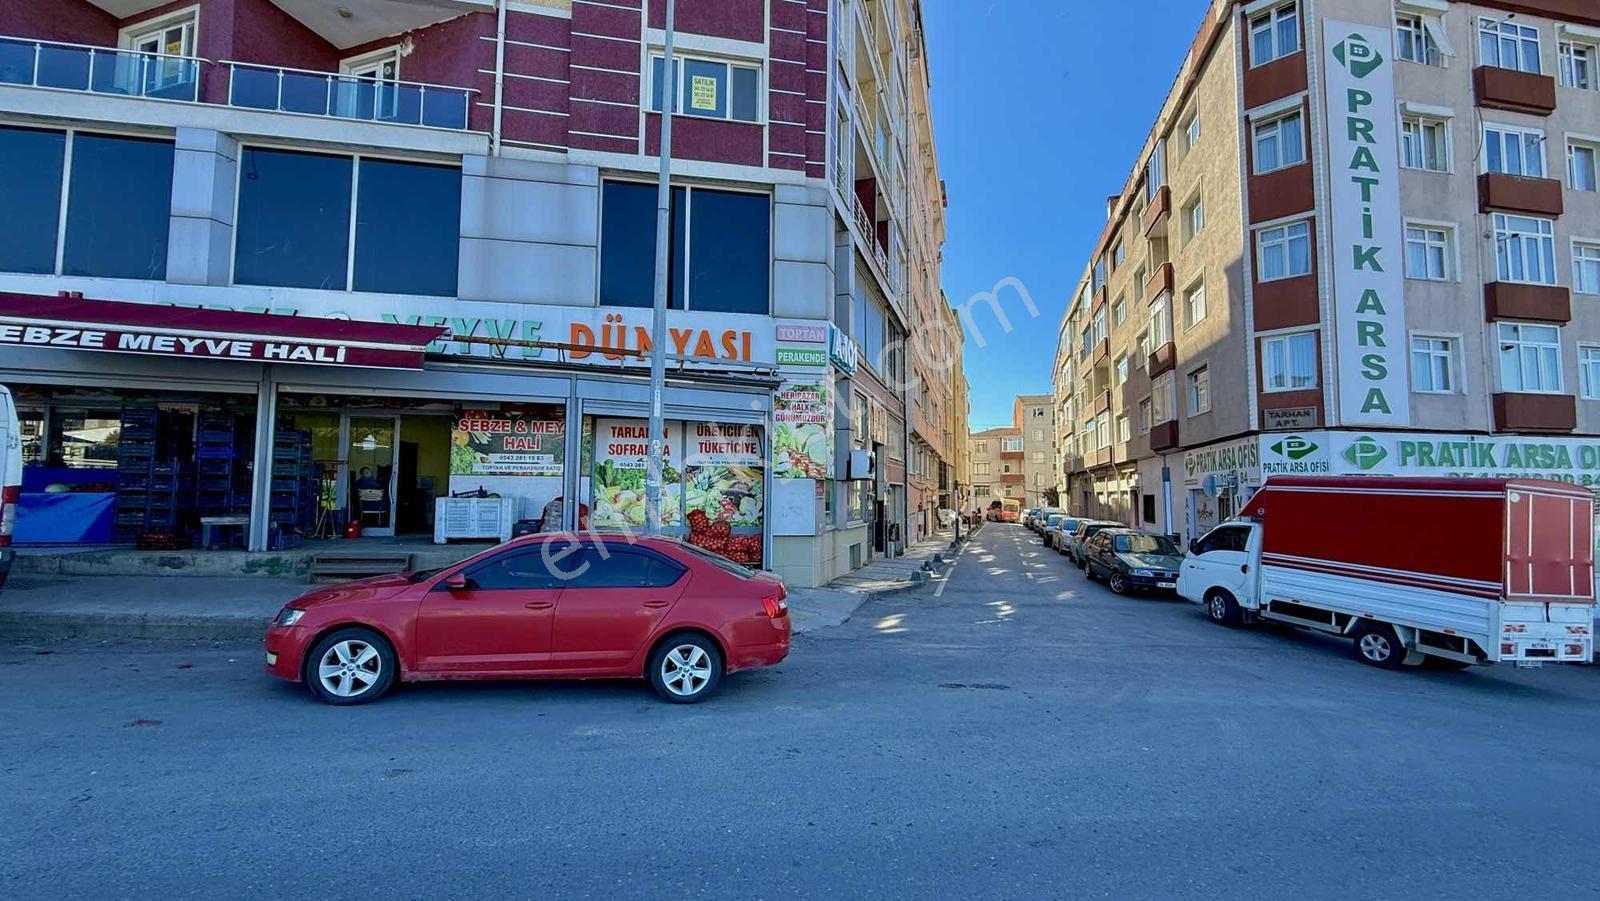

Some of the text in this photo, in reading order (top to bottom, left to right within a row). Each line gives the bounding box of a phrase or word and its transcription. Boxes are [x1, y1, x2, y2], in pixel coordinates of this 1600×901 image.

[1346, 88, 1392, 415] PRATİK ARSA
[779, 328, 825, 340] TOPTAN
[118, 333, 253, 357] MEYVE
[263, 342, 346, 363] HALİ
[778, 351, 826, 363] PERAKENDE
[781, 391, 820, 400] HER PAZAR
[791, 403, 811, 411] HALK
[1268, 410, 1311, 419] TARHAN
[460, 420, 511, 433] SEBZE
[515, 421, 527, 433] &
[504, 435, 541, 449] HALİ
[699, 440, 757, 454] TÜKETİCİYE
[1196, 437, 1259, 473] PRATİK ARSA OFİSİ
[1397, 436, 1497, 469] PRATİK
[1504, 443, 1574, 470] ARSA
[1263, 458, 1329, 473] PRATİK ARSA OFİSİ
